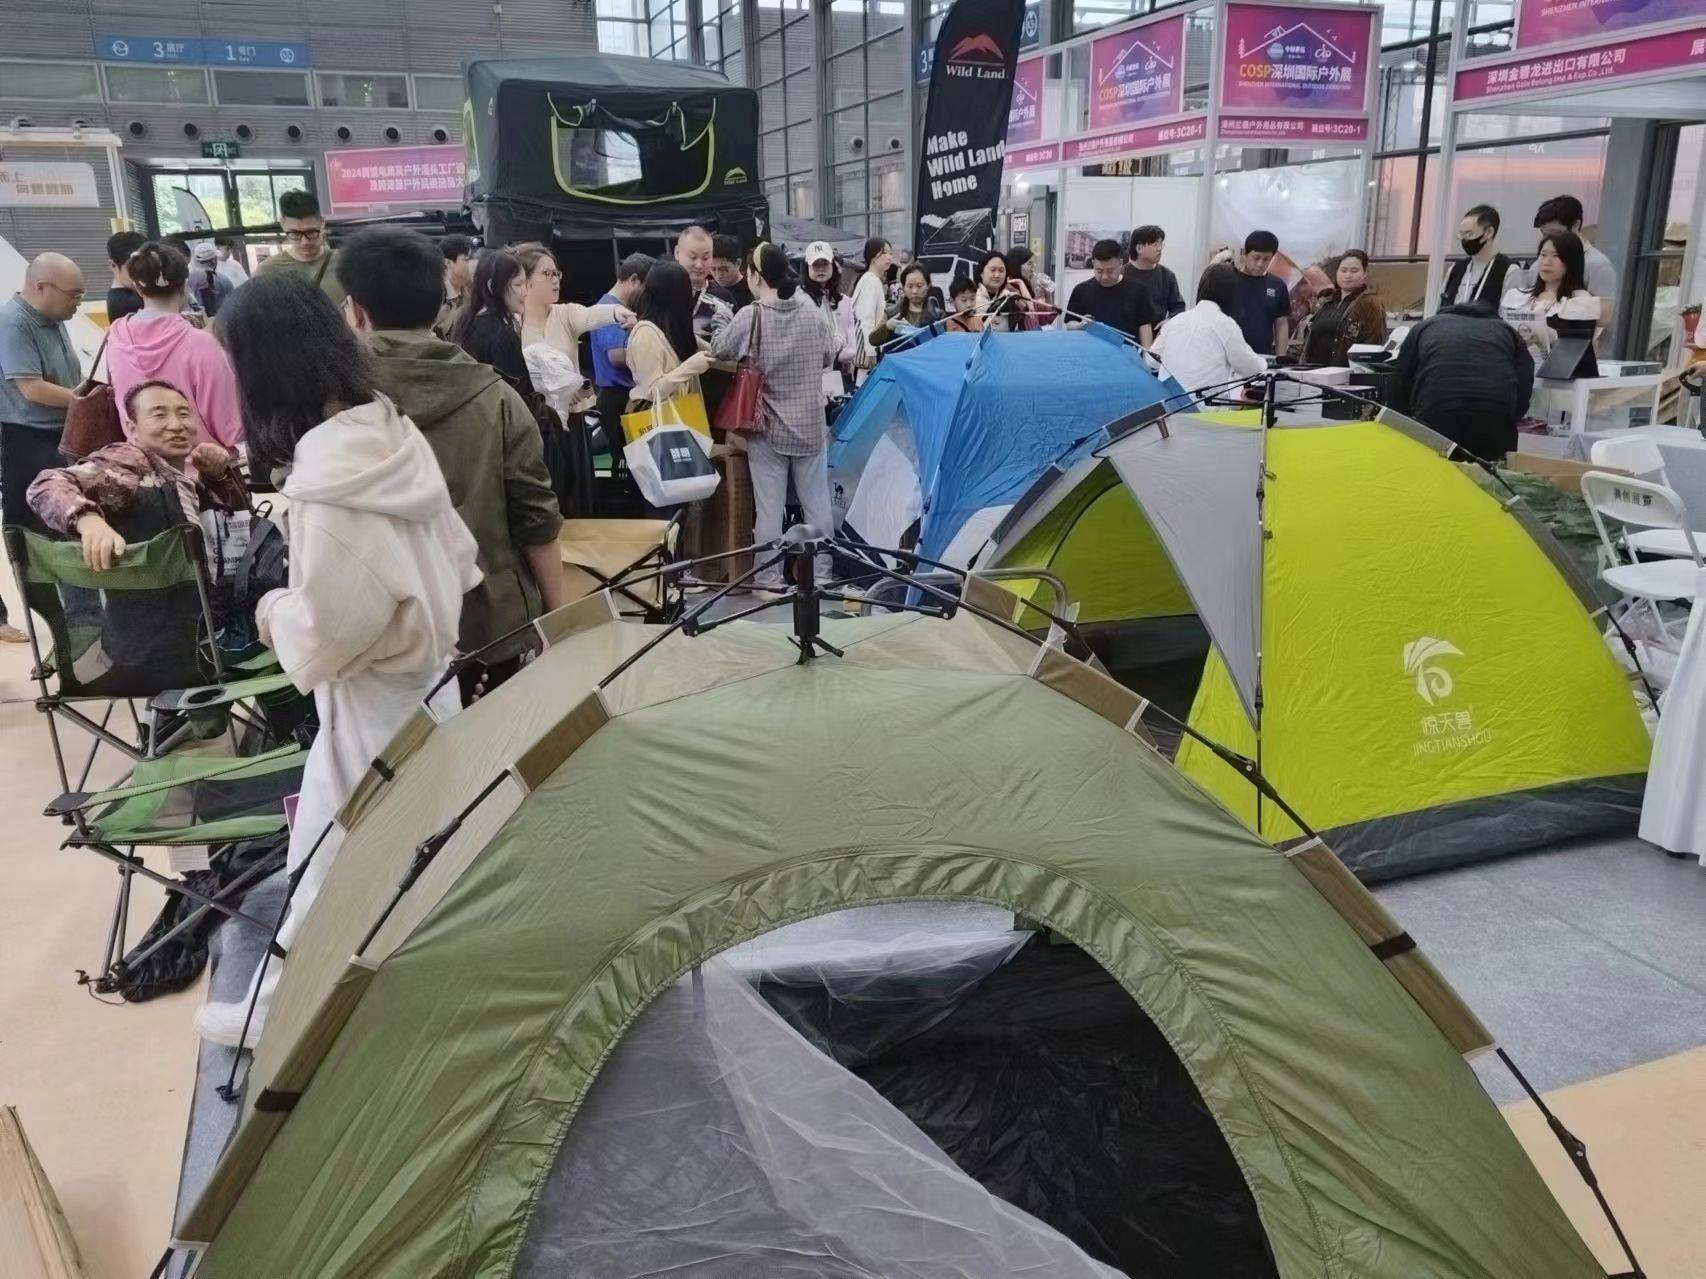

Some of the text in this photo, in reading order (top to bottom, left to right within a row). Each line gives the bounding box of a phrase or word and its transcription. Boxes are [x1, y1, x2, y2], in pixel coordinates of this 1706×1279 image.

[153, 41, 164, 58] 3
[225, 44, 236, 60] 1
[920, 50, 928, 73] 3
[945, 64, 1006, 79] Wild Land
[1239, 63, 1352, 82] COSP深圳国际户外展
[1100, 73, 1171, 100] COSP深圳国际户外展
[927, 131, 968, 155] Make
[927, 139, 1006, 177] Wild Land
[931, 174, 978, 200] Home
[1421, 710, 1472, 735] 惊天兽
